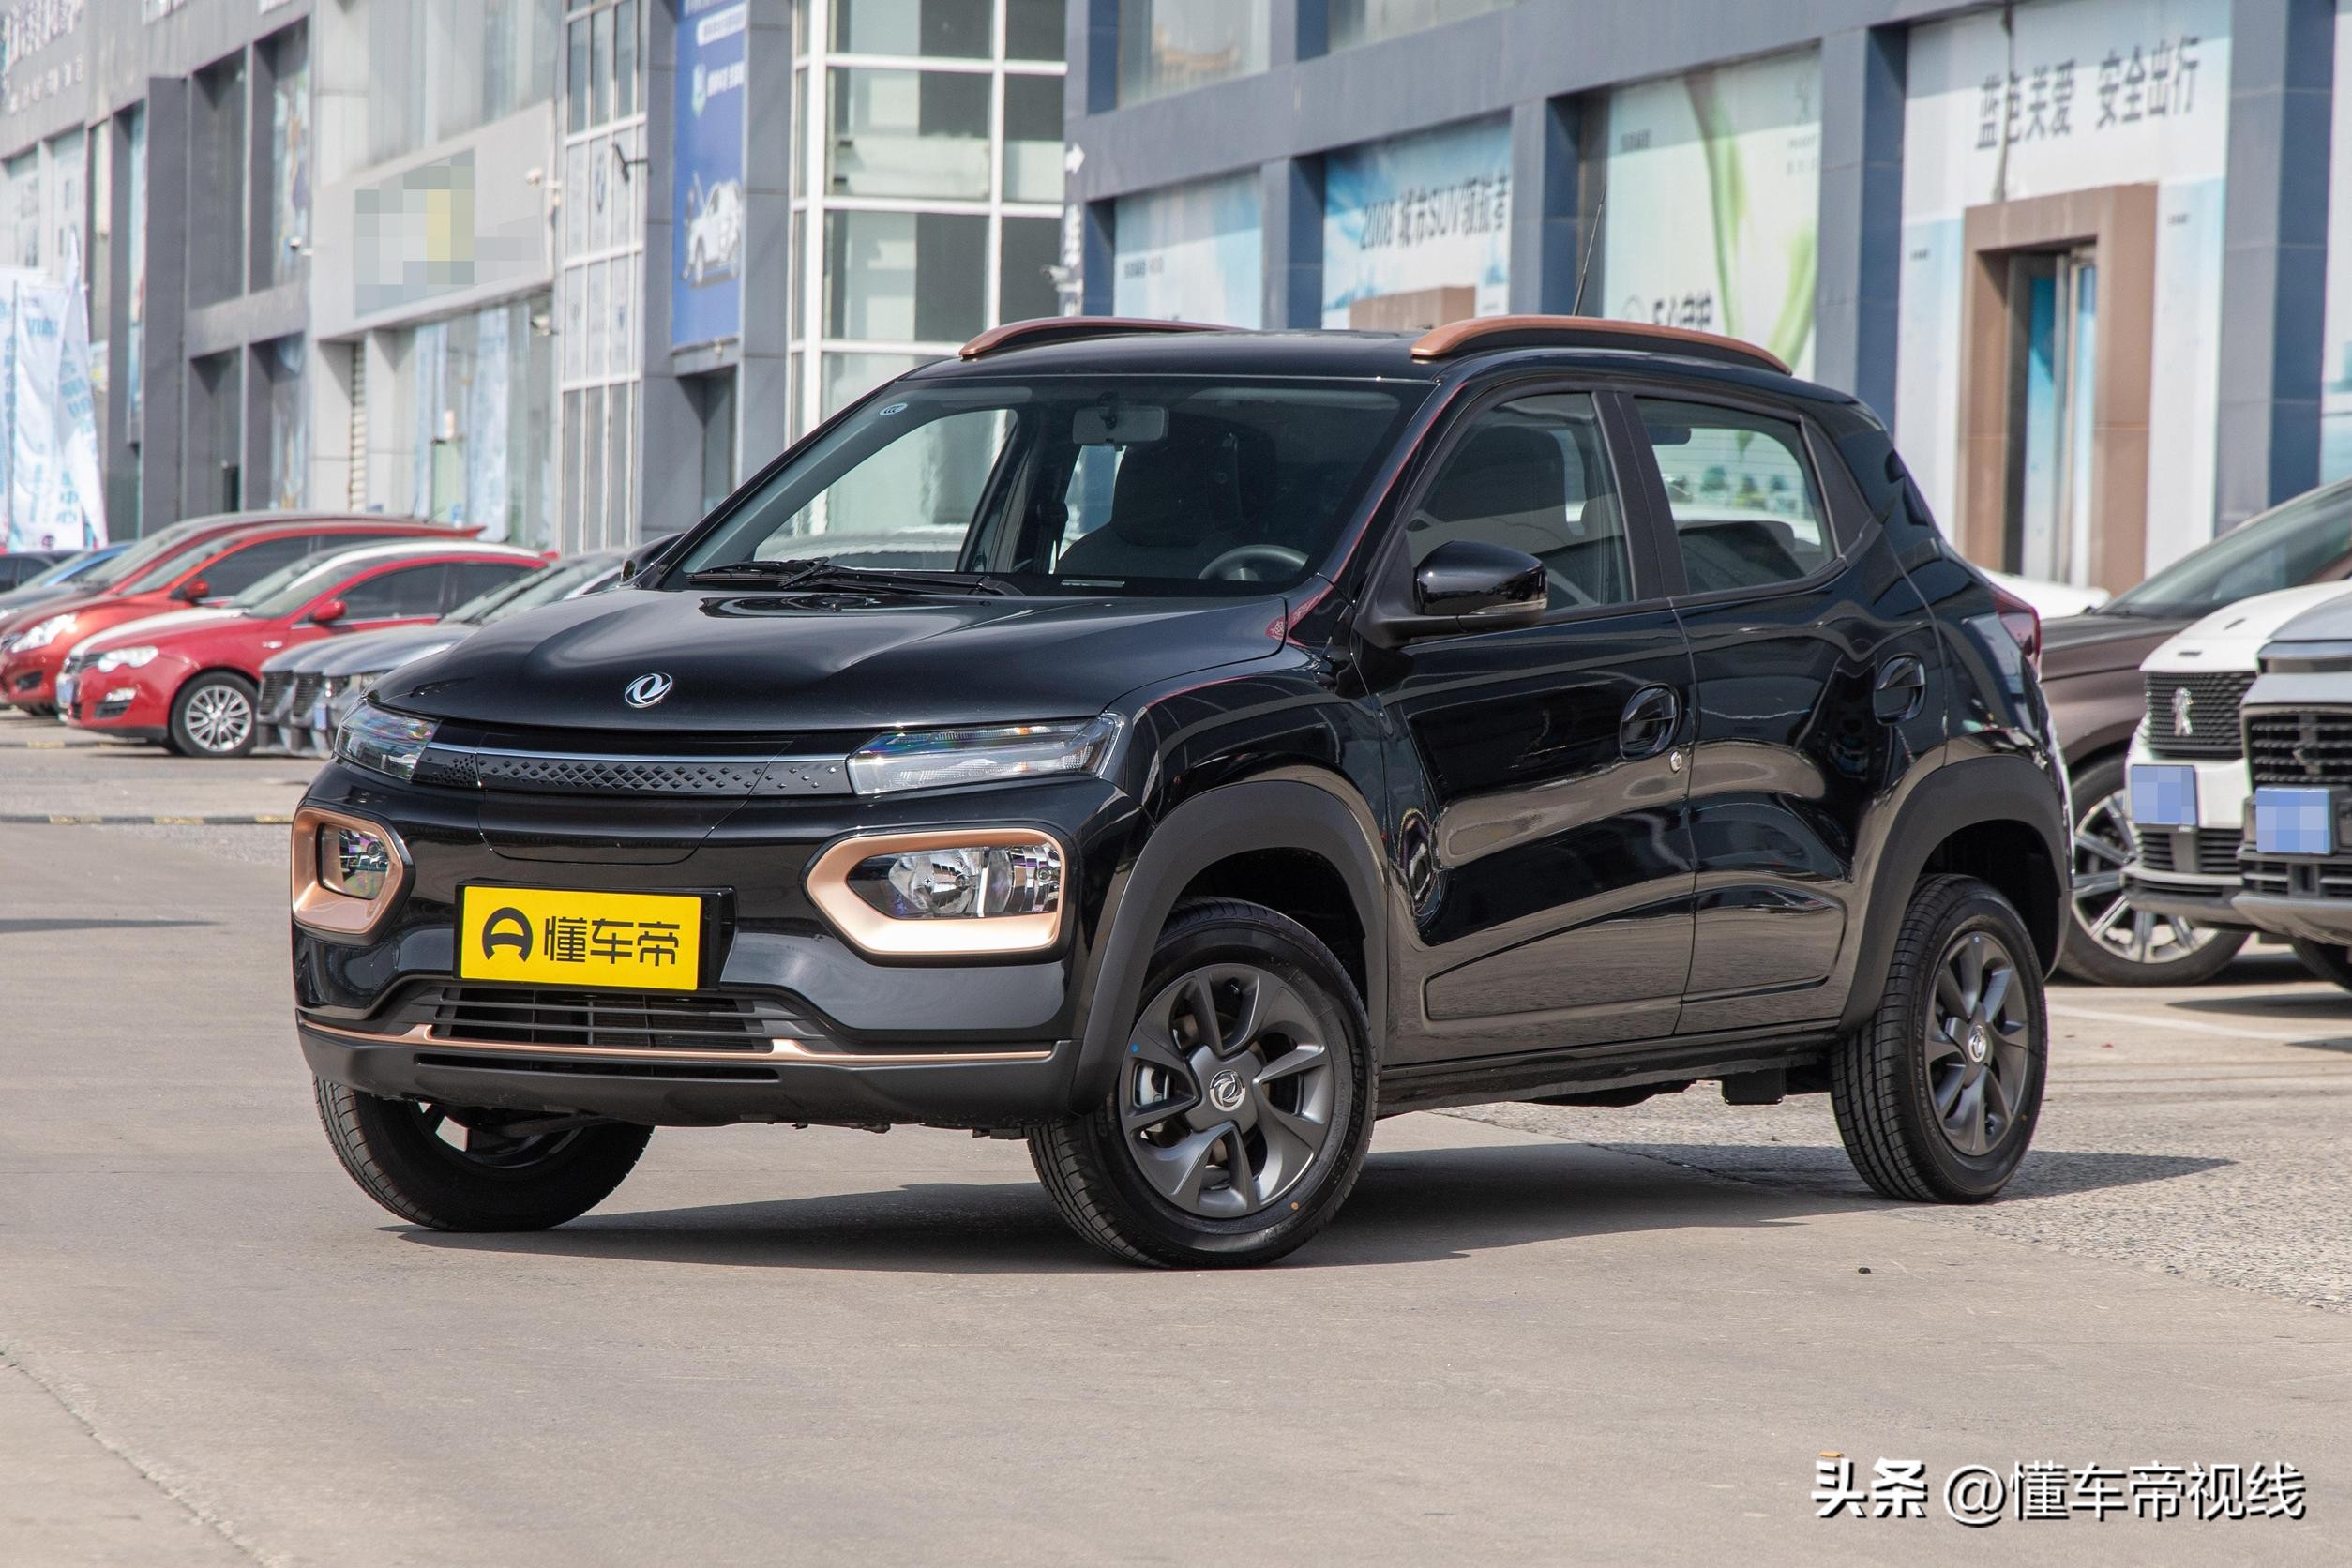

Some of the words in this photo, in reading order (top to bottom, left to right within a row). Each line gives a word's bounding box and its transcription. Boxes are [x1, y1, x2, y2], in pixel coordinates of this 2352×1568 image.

[1976, 58, 2075, 150] 蓝色关爱
[2095, 36, 2200, 131] 安全出行
[543, 914, 681, 967] 懂车帝
